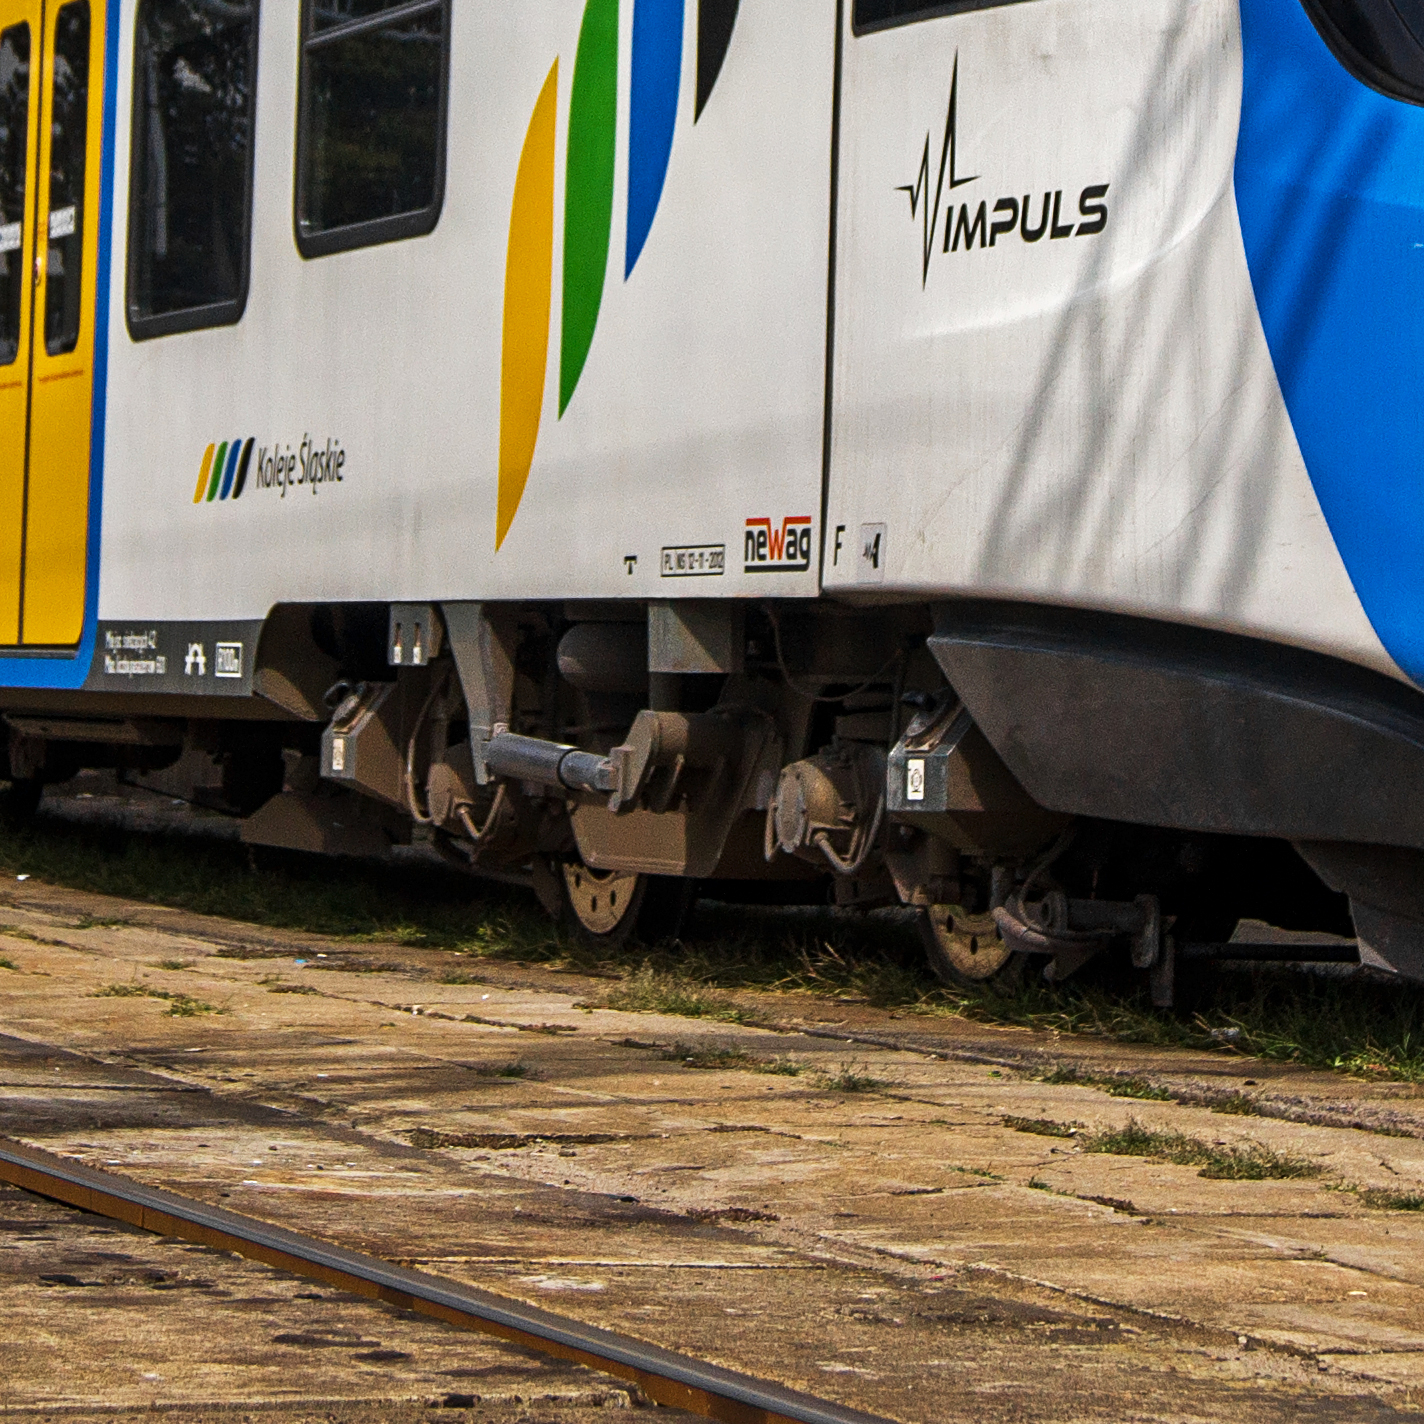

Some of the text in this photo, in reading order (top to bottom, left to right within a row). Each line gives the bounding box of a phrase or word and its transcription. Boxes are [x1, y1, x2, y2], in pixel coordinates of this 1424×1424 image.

[942, 183, 1111, 253] IMPULS
[257, 432, 345, 498] Koleje Śląskie
